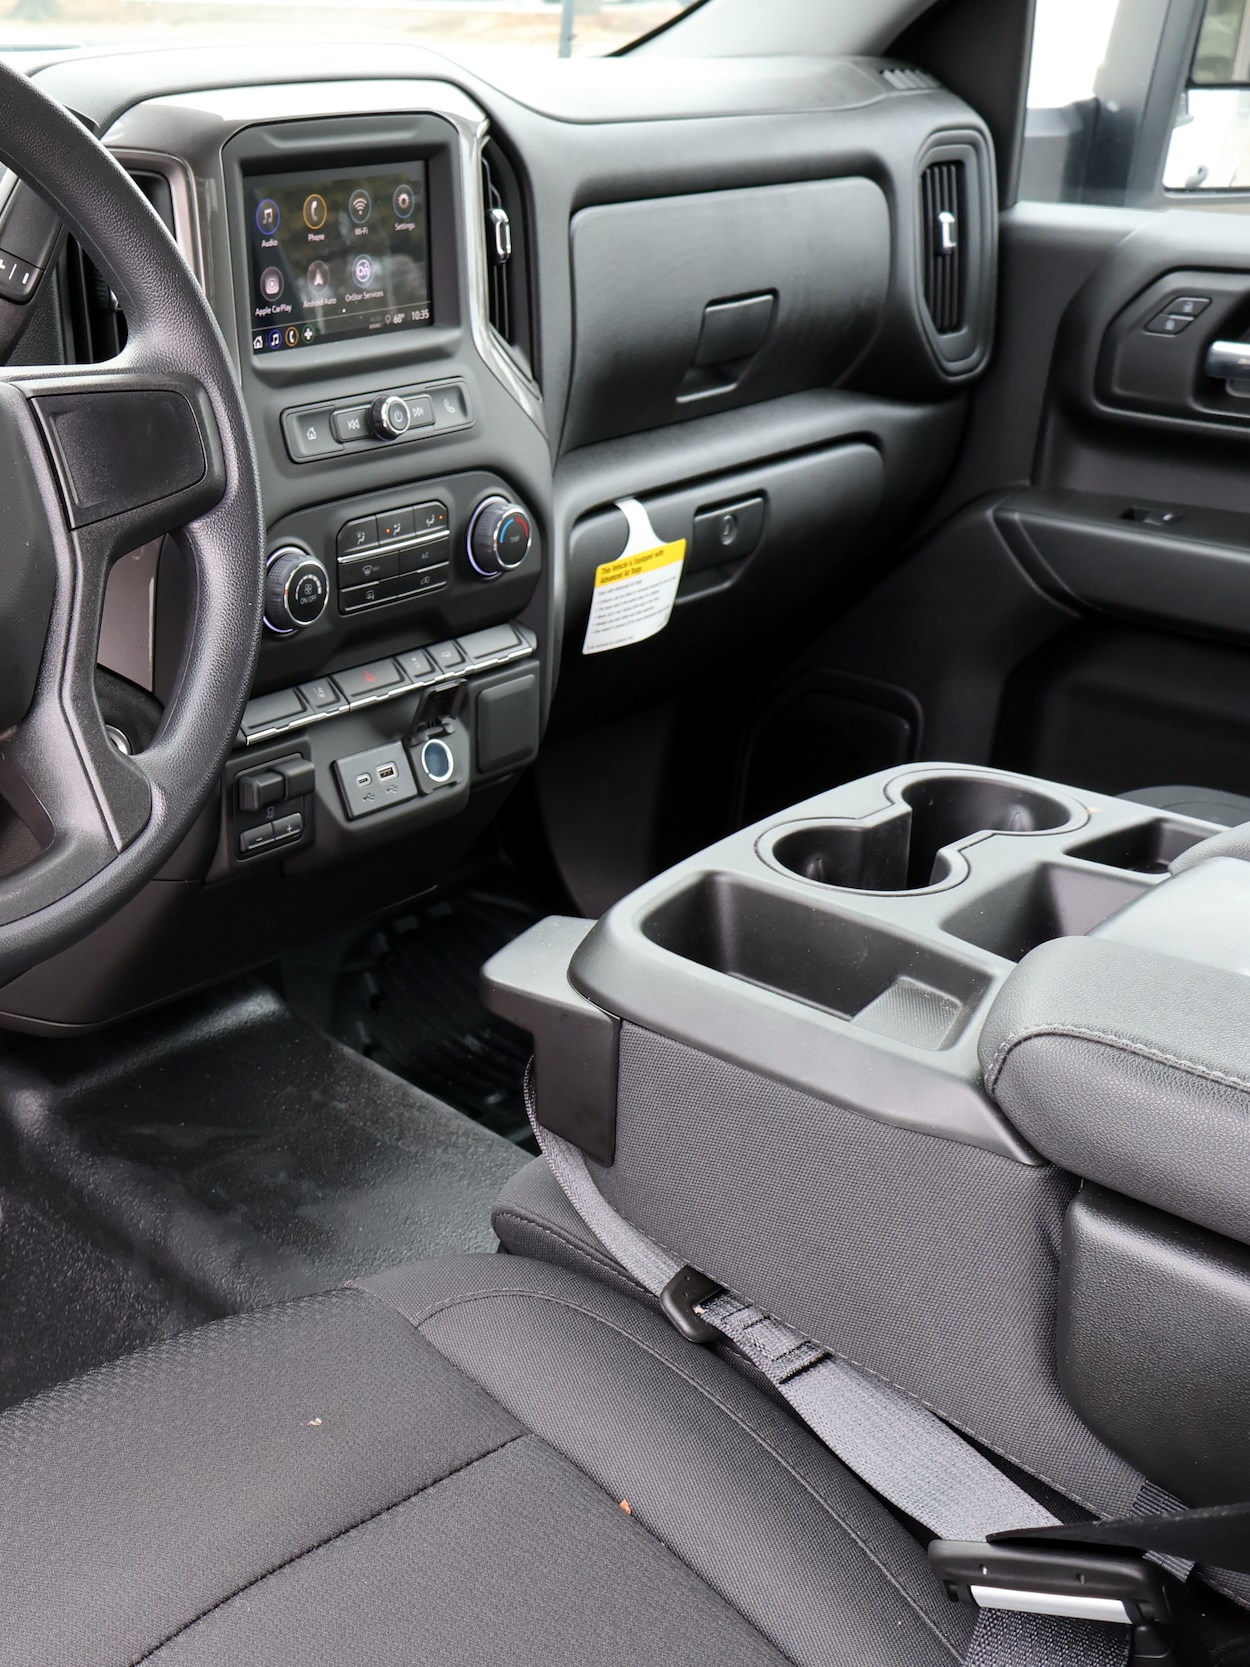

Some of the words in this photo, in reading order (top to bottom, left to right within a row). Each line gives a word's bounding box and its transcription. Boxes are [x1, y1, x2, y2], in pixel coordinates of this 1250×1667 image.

[354, 227, 369, 236] Wi-Fi
[395, 222, 415, 231] Settings
[308, 233, 325, 243] Phone
[261, 239, 279, 248] Audio
[345, 293, 362, 302] OnStar
[363, 290, 384, 300] Services
[303, 298, 324, 308] Android
[255, 306, 271, 317] Apple
[272, 303, 292, 314] CarPlay
[411, 309, 430, 320] 10:35
